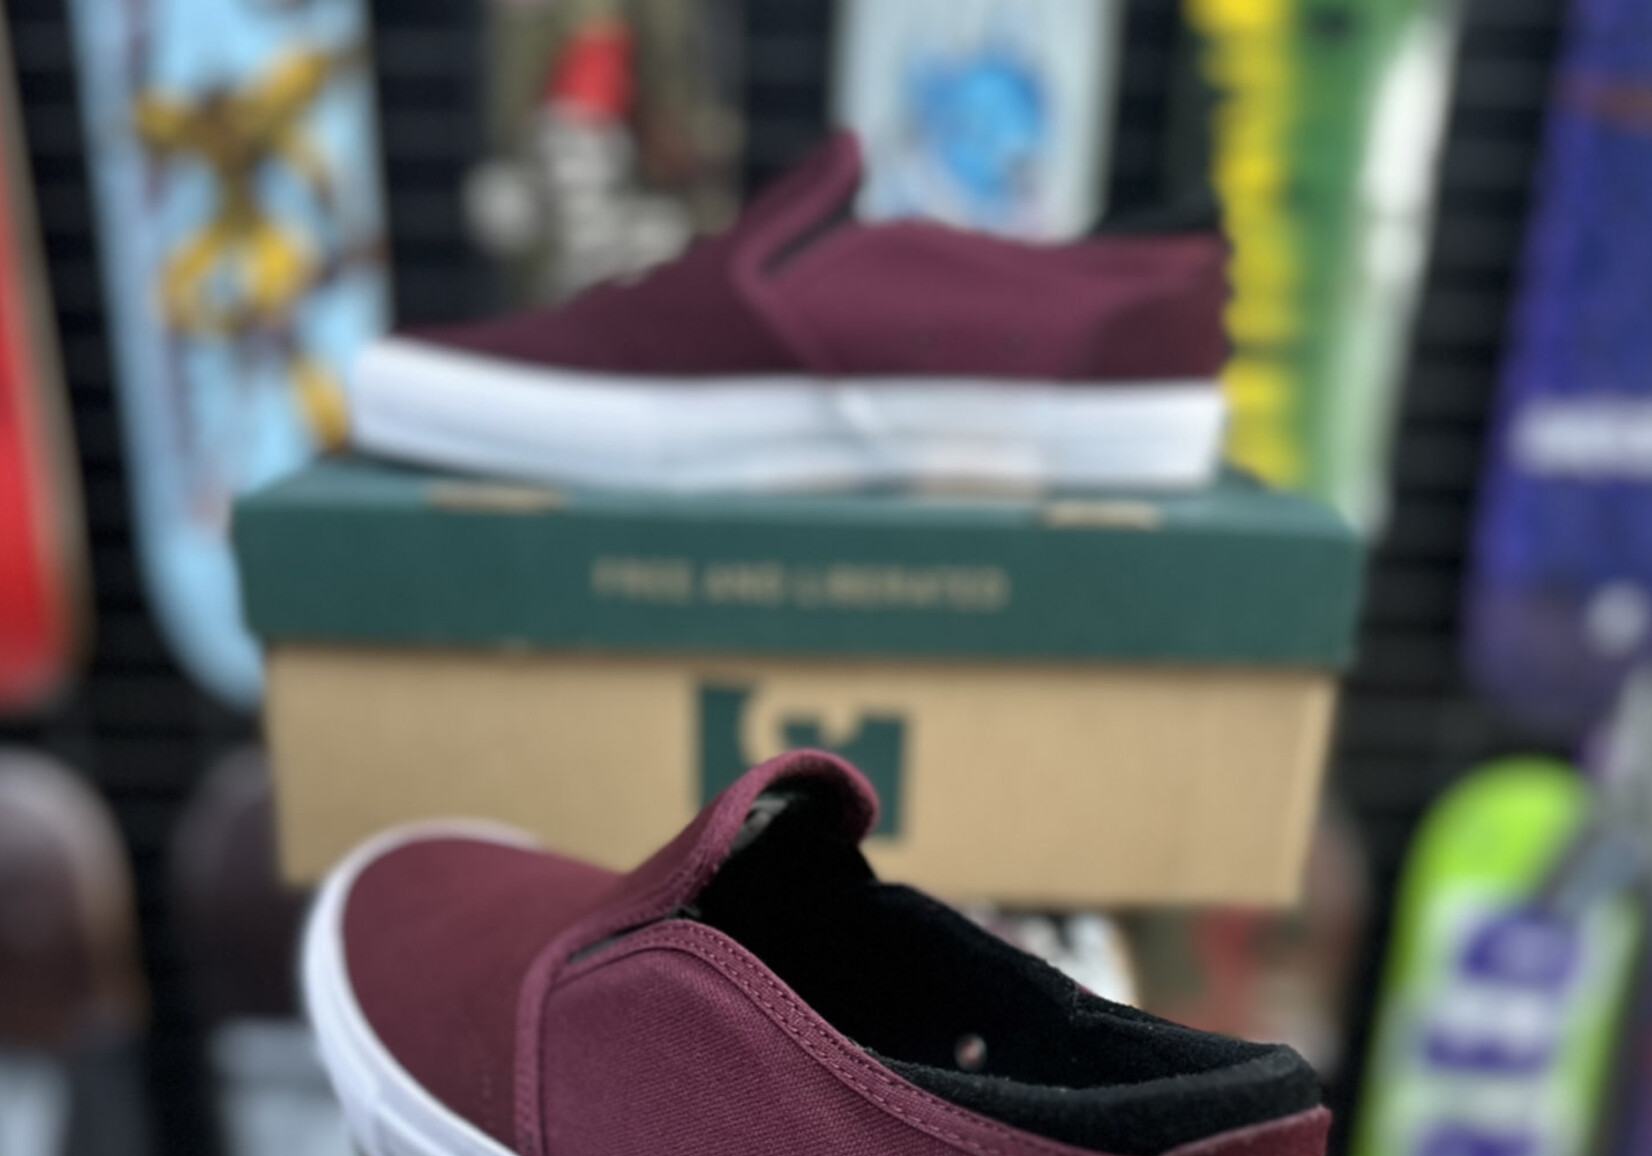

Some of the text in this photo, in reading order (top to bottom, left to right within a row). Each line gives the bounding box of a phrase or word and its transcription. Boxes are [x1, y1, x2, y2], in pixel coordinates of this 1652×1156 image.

[593, 557, 1007, 613] FREE AND LIBERATED
